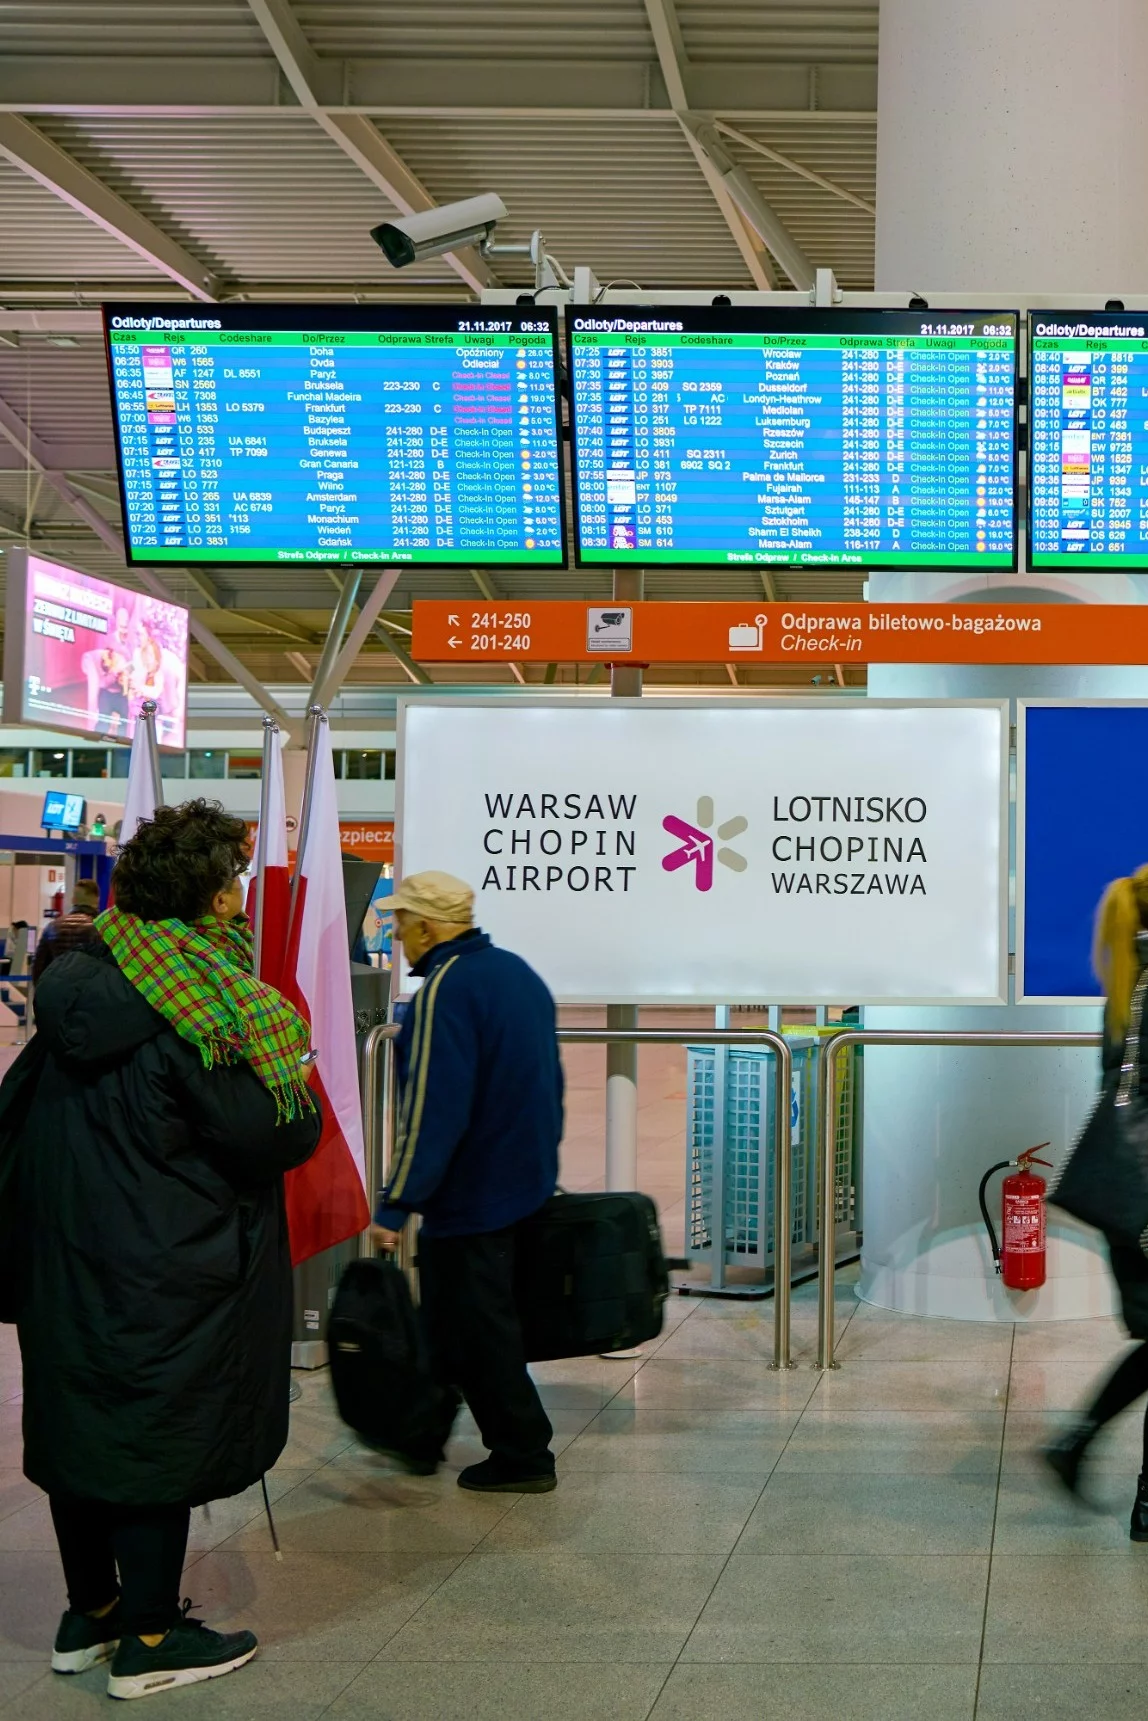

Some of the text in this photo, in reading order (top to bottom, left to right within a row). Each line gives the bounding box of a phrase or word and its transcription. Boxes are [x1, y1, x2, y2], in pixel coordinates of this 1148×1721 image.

[111, 317, 221, 331] Odloty/Departures
[459, 321, 549, 331] 21.11.2017 06:32
[574, 319, 683, 332] Odloty/Departures
[921, 324, 1012, 336] 21.11.2017 06:32
[1036, 324, 1144, 336] Odloty/Departures
[113, 333, 545, 346] Czas Rejs Codeshare Do/Przez Odprawa Strefa Uwagi Pogoda
[310, 346, 333, 355] Doha
[311, 359, 334, 367] Ovda
[766, 361, 799, 370] Kraków
[766, 372, 799, 380] Poznań
[305, 381, 343, 390] Bruksela
[576, 382, 879, 393] 07:35 LO 409 SQ 2359 Dusseldorf 241-280
[288, 392, 361, 401] Funchal Madeira
[744, 395, 821, 405] Londyn-Heathrow
[306, 404, 345, 412] Frankfurt
[763, 406, 803, 414] Mediolan
[309, 415, 344, 425] Bazylea
[756, 418, 810, 428] Luksemburg
[122, 425, 146, 433] 07:05
[304, 426, 350, 436] Budapeszt
[387, 427, 422, 435] 241-280
[431, 427, 447, 435] D-E
[492, 428, 512, 437] Open
[763, 428, 804, 437] Rzeszów
[764, 439, 803, 448] Szczecin
[311, 449, 347, 457] Genewa
[770, 451, 797, 459] Zurich
[324, 460, 358, 468] Canaria
[764, 462, 803, 470] Frankfurt
[317, 471, 343, 481] Praga
[743, 472, 824, 482] Palma de Mallorca
[320, 482, 343, 490] Wilno
[767, 484, 802, 494] Fujairah
[307, 493, 356, 501] Amsterdam
[758, 495, 811, 503] Marsa-Alam
[308, 515, 359, 523] Monachium
[762, 517, 808, 525] Sztokholm
[749, 528, 776, 536] Sharm
[792, 528, 821, 536] Sheikh
[759, 540, 812, 548] Marsa-Alam
[472, 613, 530, 628] 241-250
[782, 613, 1040, 634] Odprawa biletowo-bagażowa
[471, 635, 530, 649] 201-240
[781, 635, 861, 650] Check-in
[485, 794, 637, 819] WARSAW
[774, 796, 926, 823] LOTNISKO
[484, 829, 634, 855] CHOPIN
[772, 836, 927, 862] CHOPINA
[482, 866, 636, 891] AIRPORT
[771, 873, 926, 895] WARSZAWA
